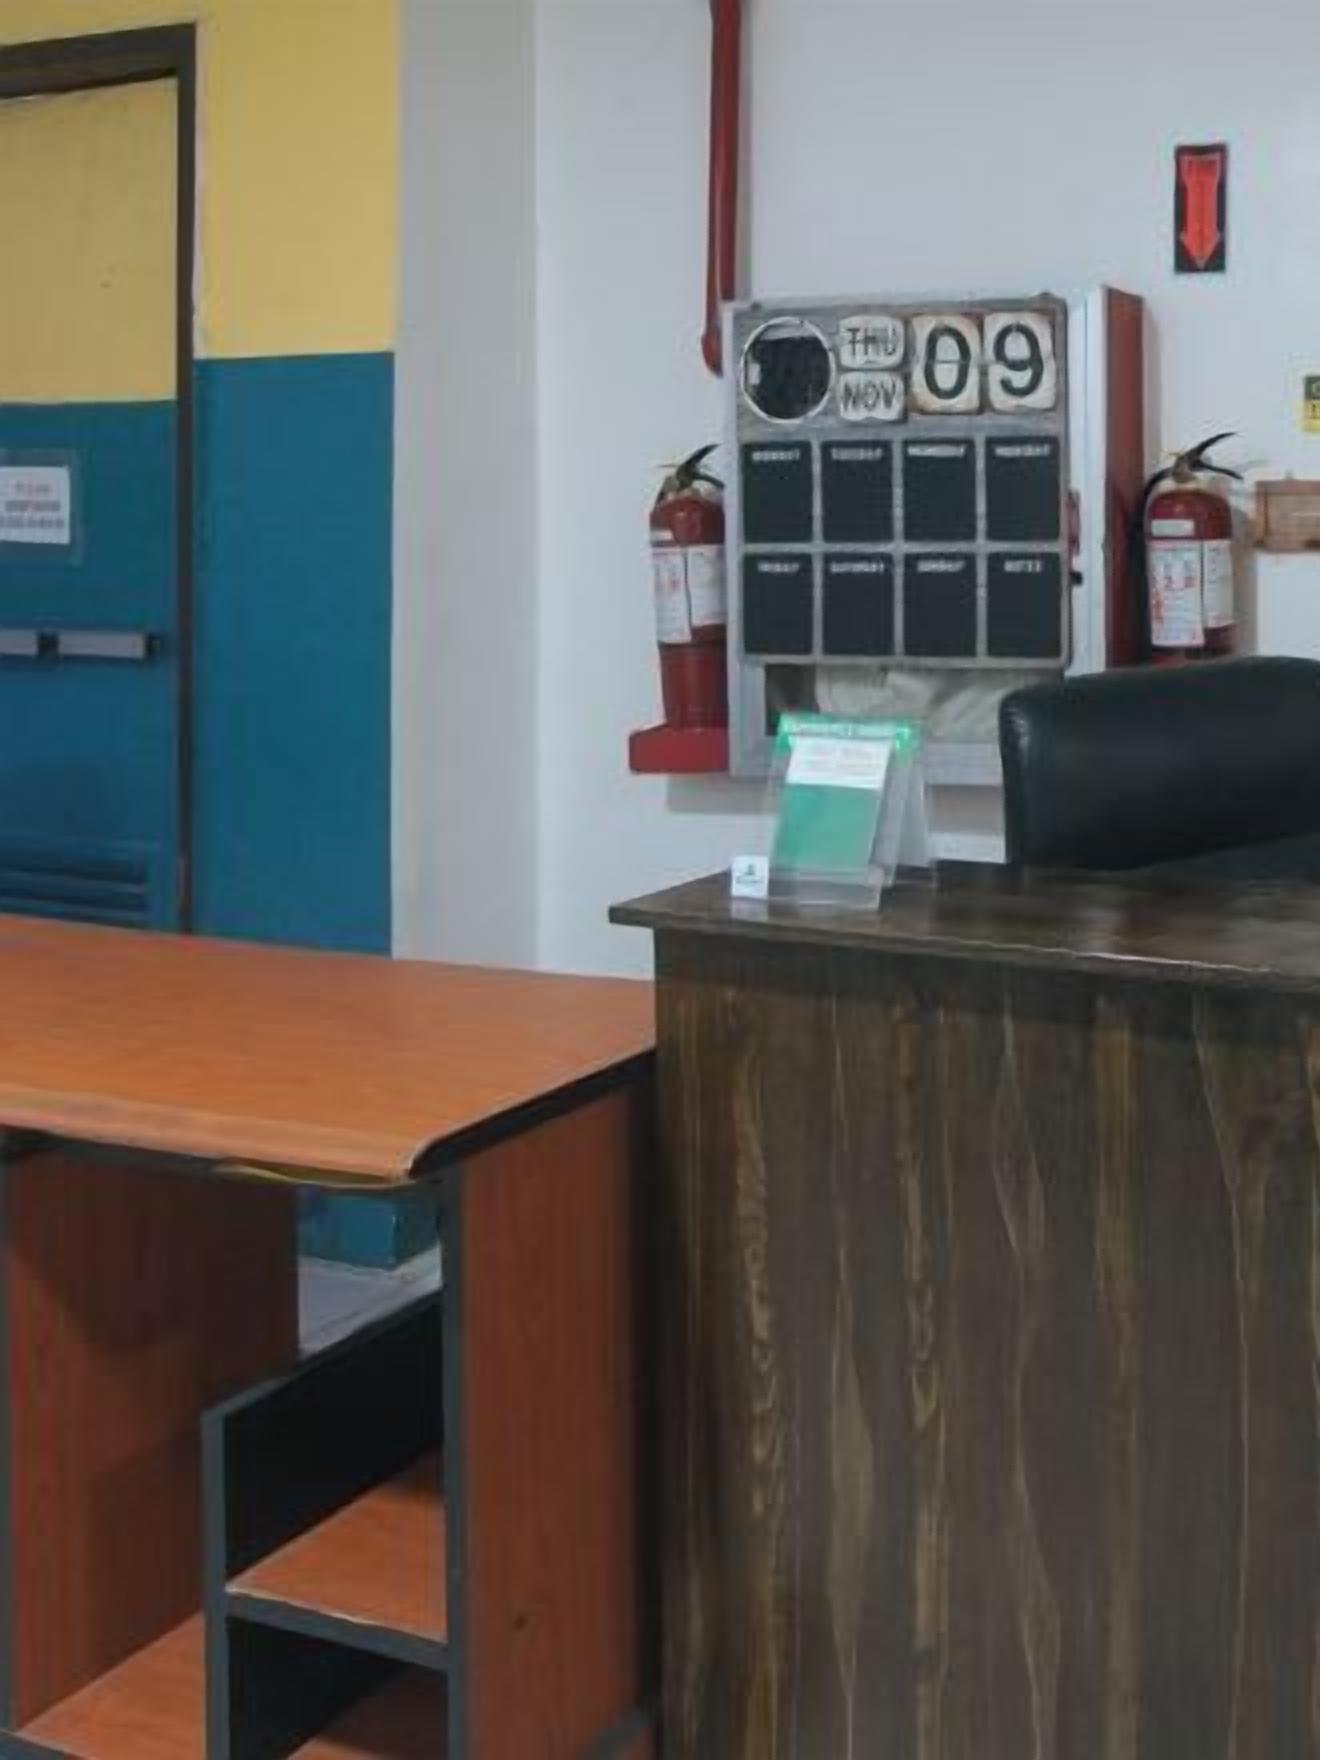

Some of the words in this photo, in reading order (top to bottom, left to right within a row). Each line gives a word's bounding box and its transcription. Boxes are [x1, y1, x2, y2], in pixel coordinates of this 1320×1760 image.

[846, 328, 897, 357] THU
[923, 322, 1045, 400] 09
[844, 380, 896, 412] NOV
